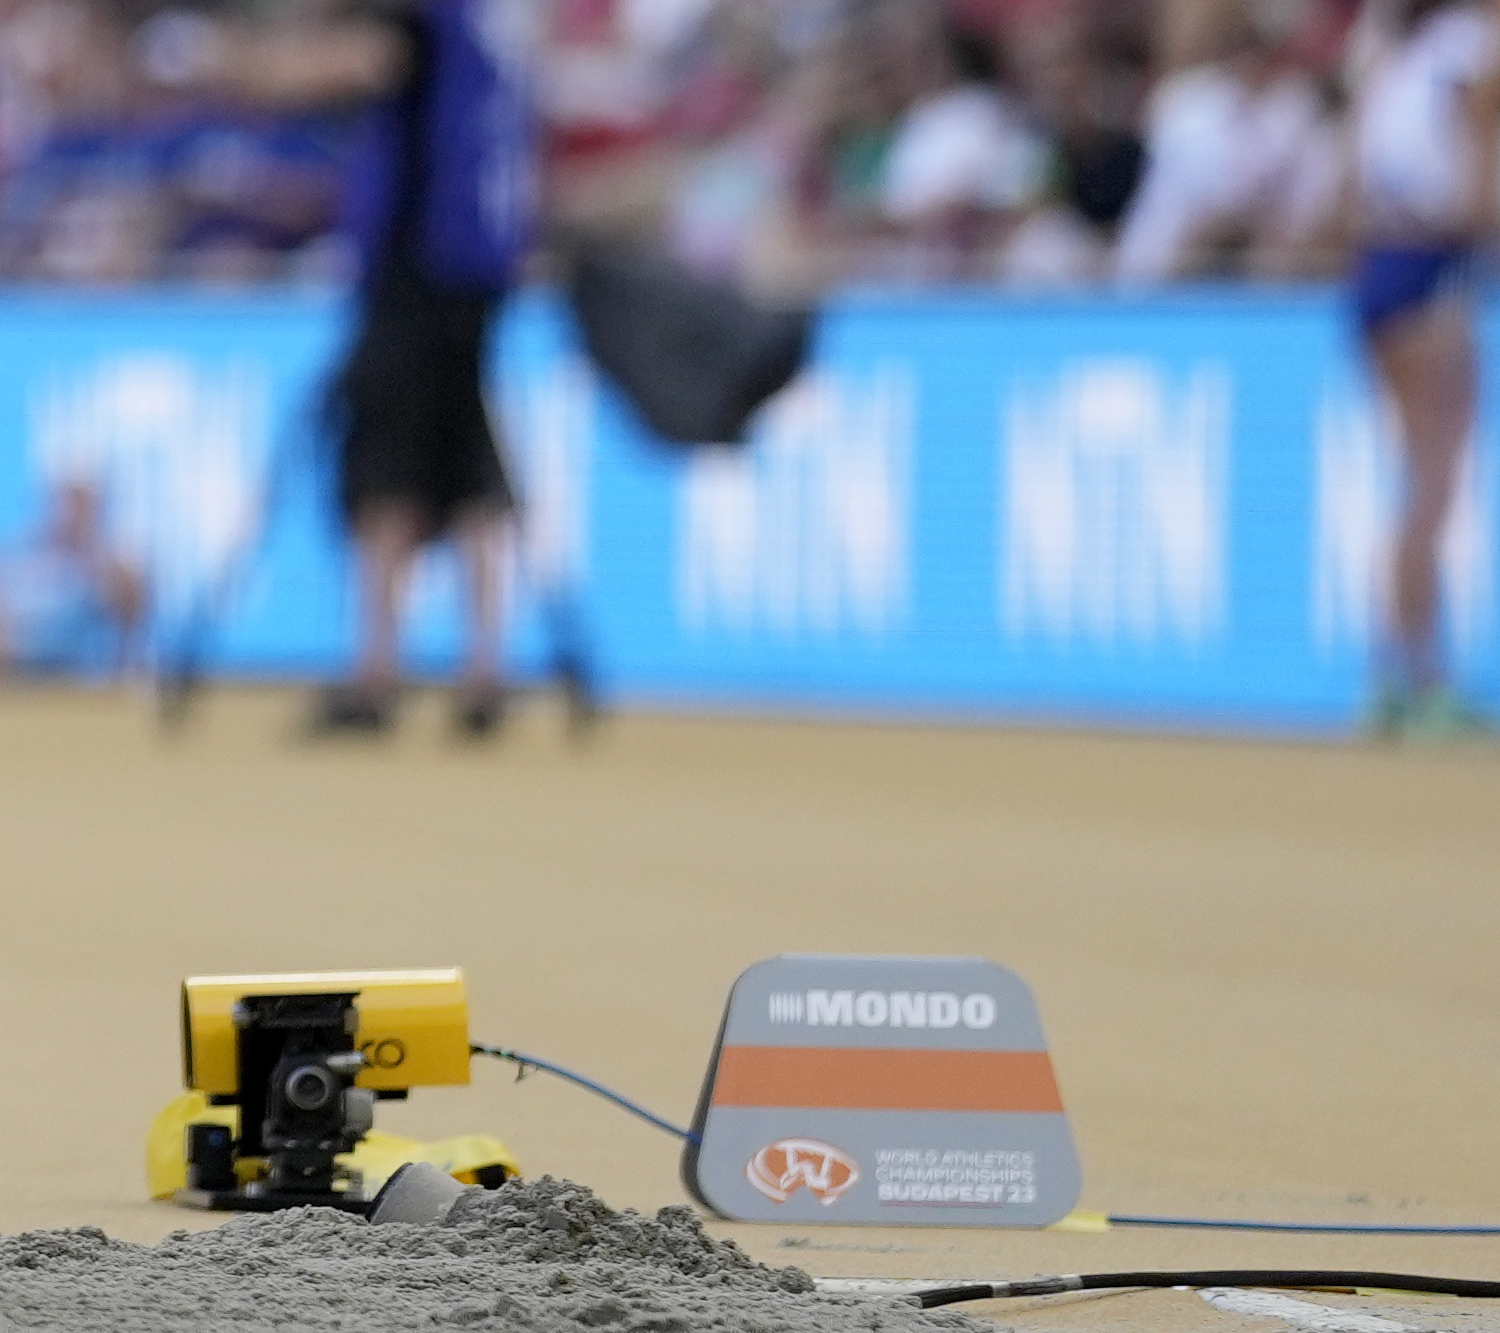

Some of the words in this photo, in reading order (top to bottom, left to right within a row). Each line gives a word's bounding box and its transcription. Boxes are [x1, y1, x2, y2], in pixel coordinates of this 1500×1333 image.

[806, 988, 996, 1030] MONDO
[875, 1165, 1035, 1185] CHAMPIONSHIPS
[878, 1183, 1004, 1202] BUDAPEST
